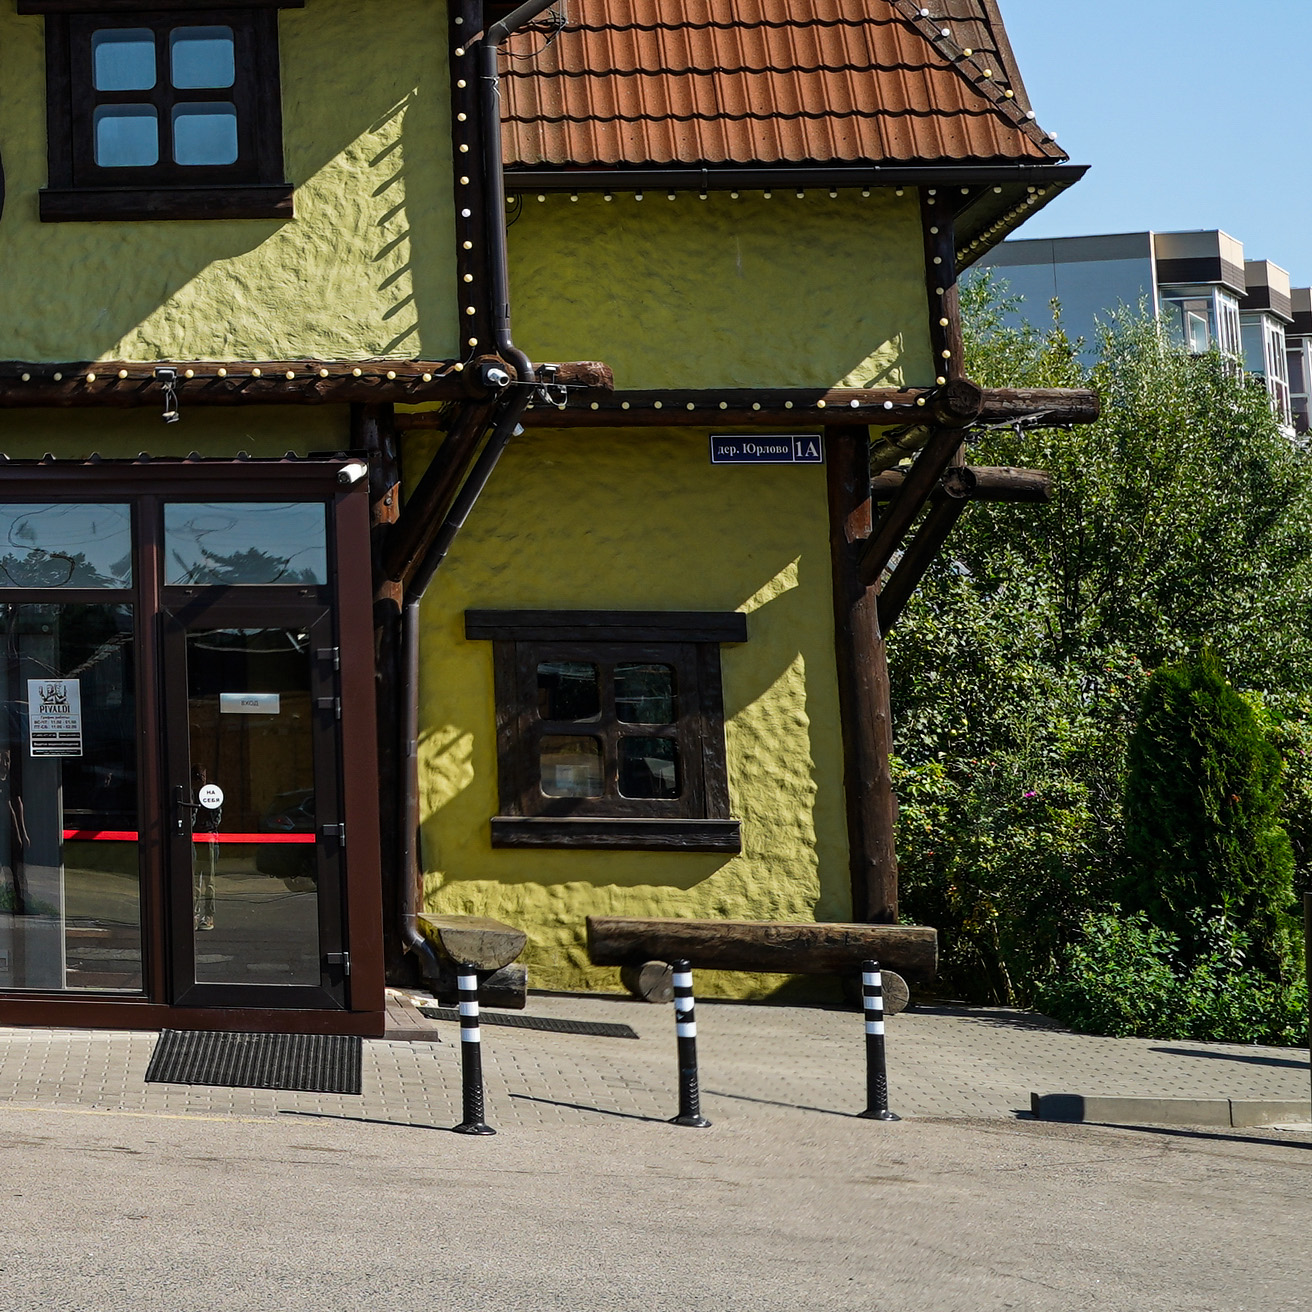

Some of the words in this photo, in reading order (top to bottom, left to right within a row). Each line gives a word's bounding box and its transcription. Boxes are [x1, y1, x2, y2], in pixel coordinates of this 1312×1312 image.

[717, 445, 740, 457] дер.
[743, 443, 789, 457] Юрлово
[39, 705, 70, 713] PIVALDI
